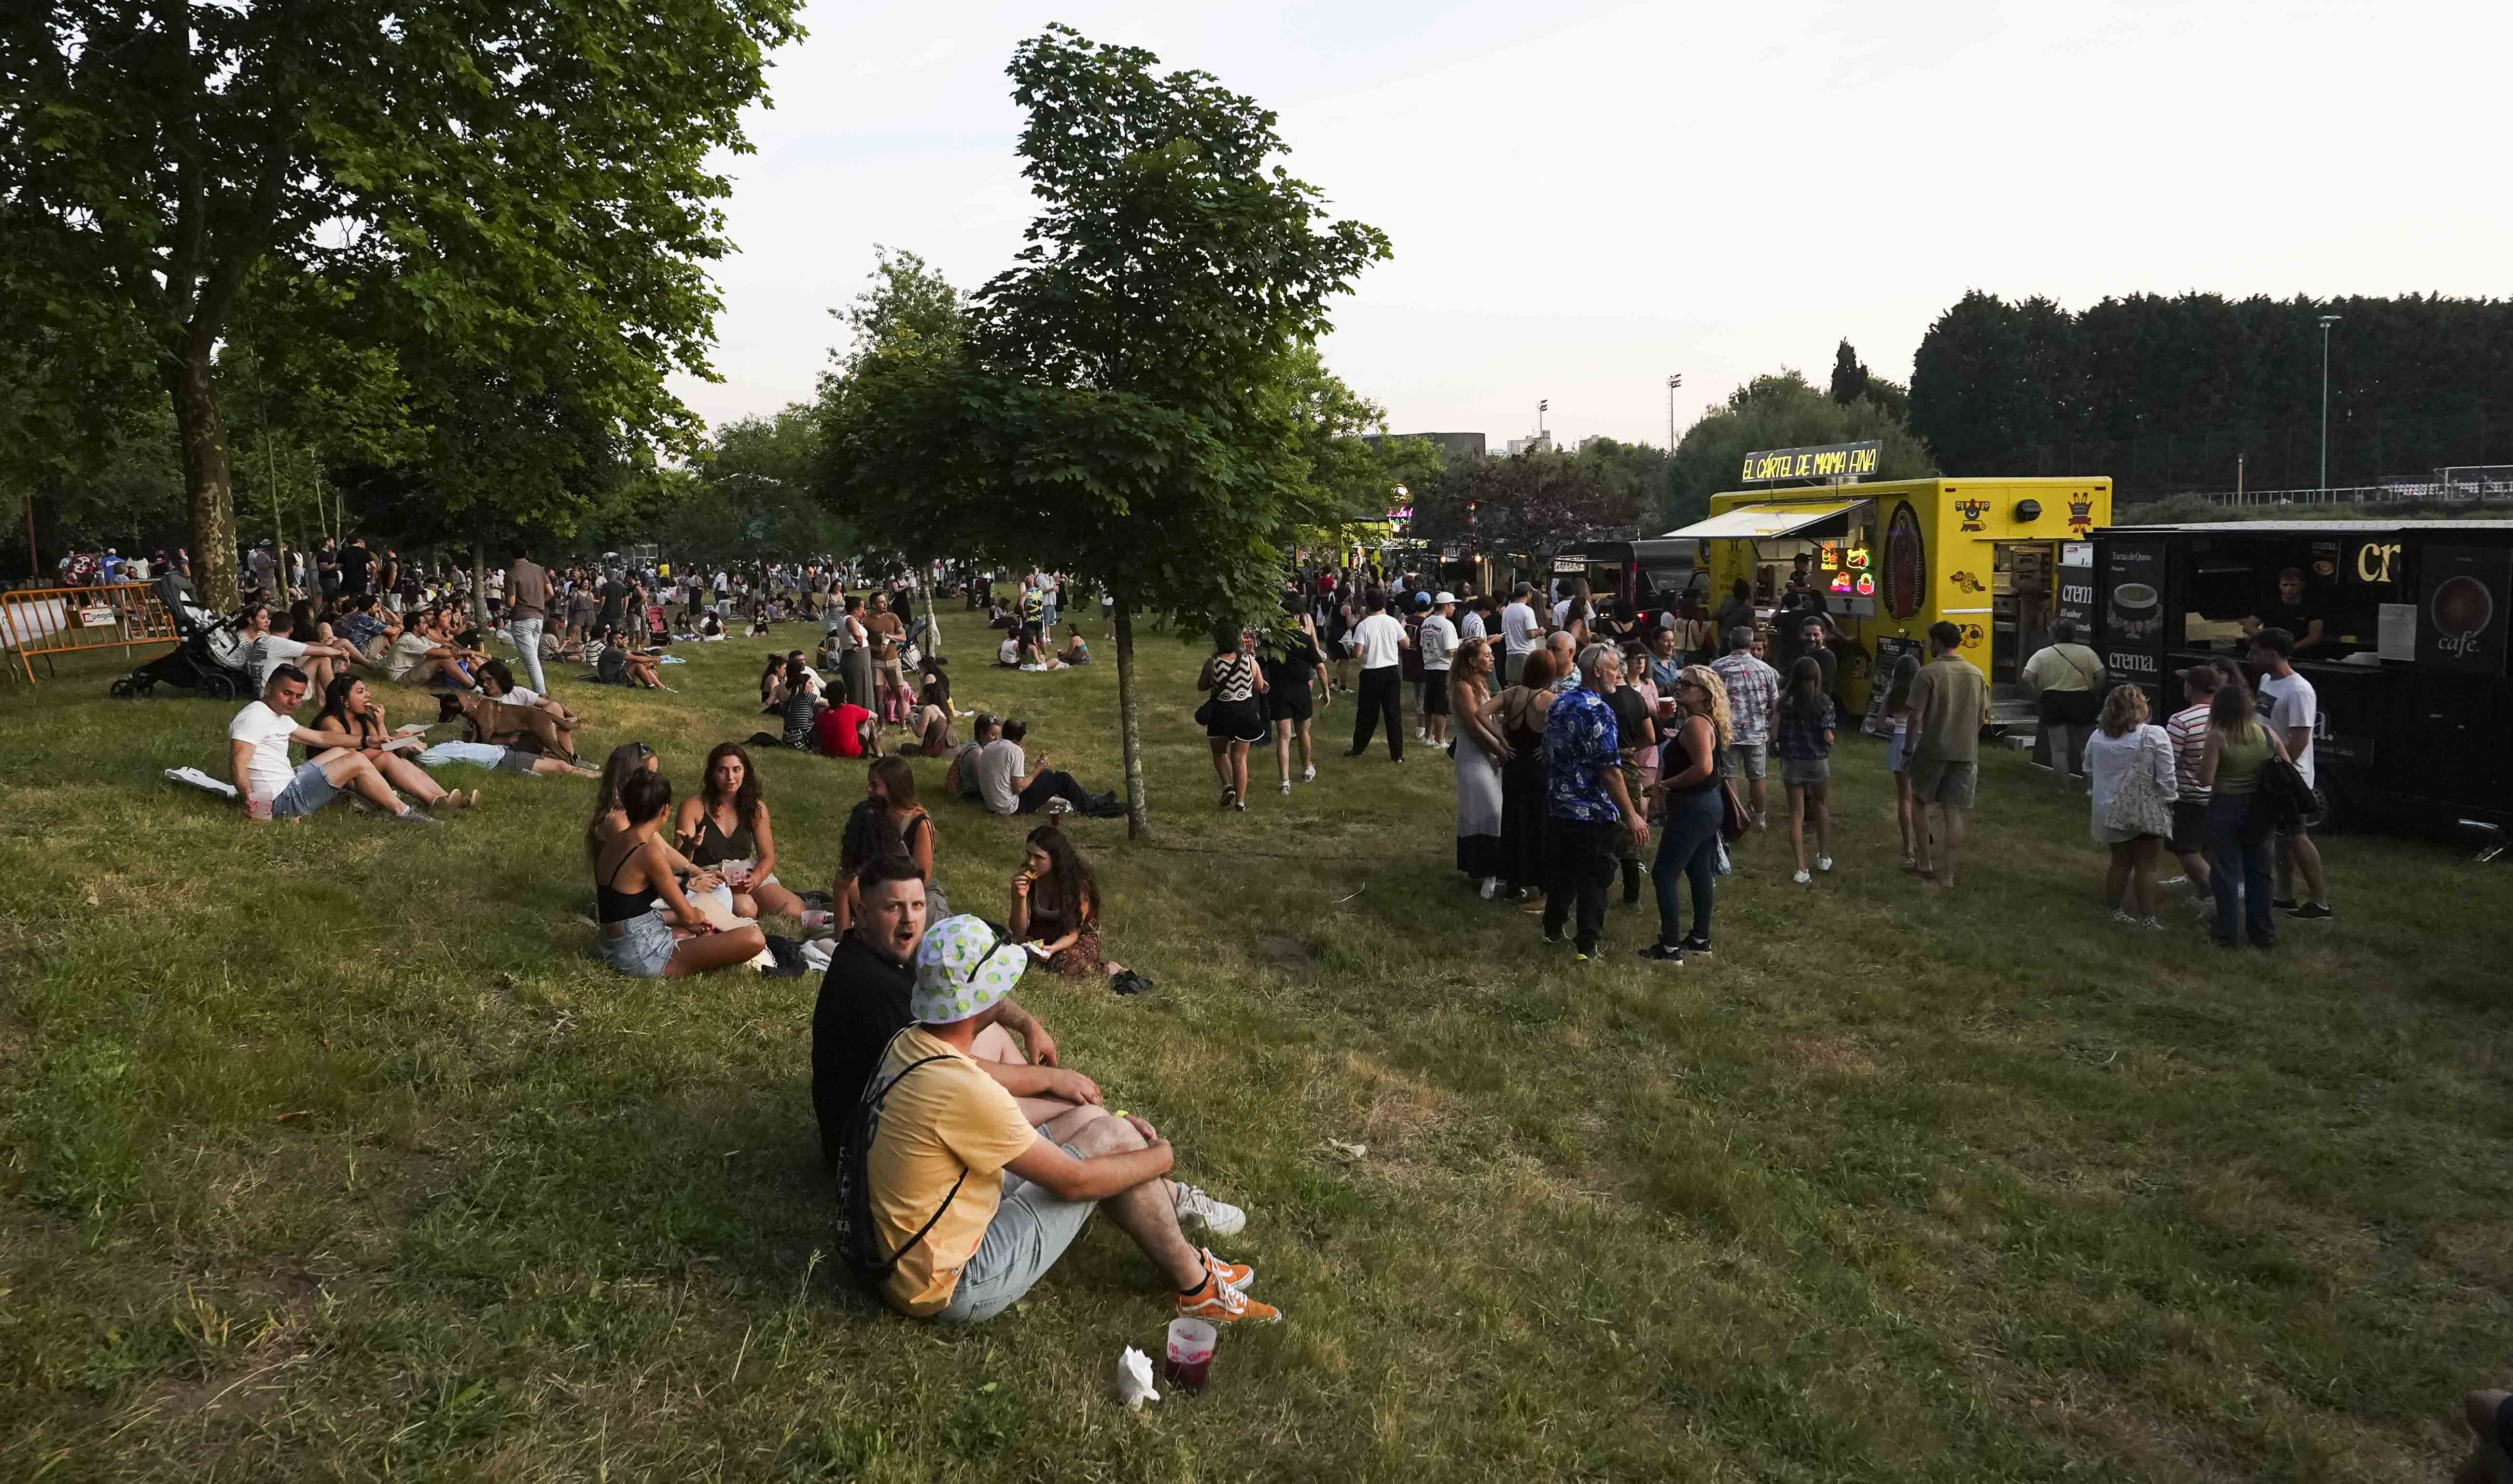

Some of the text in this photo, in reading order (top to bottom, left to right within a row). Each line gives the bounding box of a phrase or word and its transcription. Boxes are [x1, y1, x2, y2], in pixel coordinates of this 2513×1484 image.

[1743, 448, 1876, 479] EL CÁRTEL DE MAMA FINA
[2109, 652, 2158, 672] crema.
